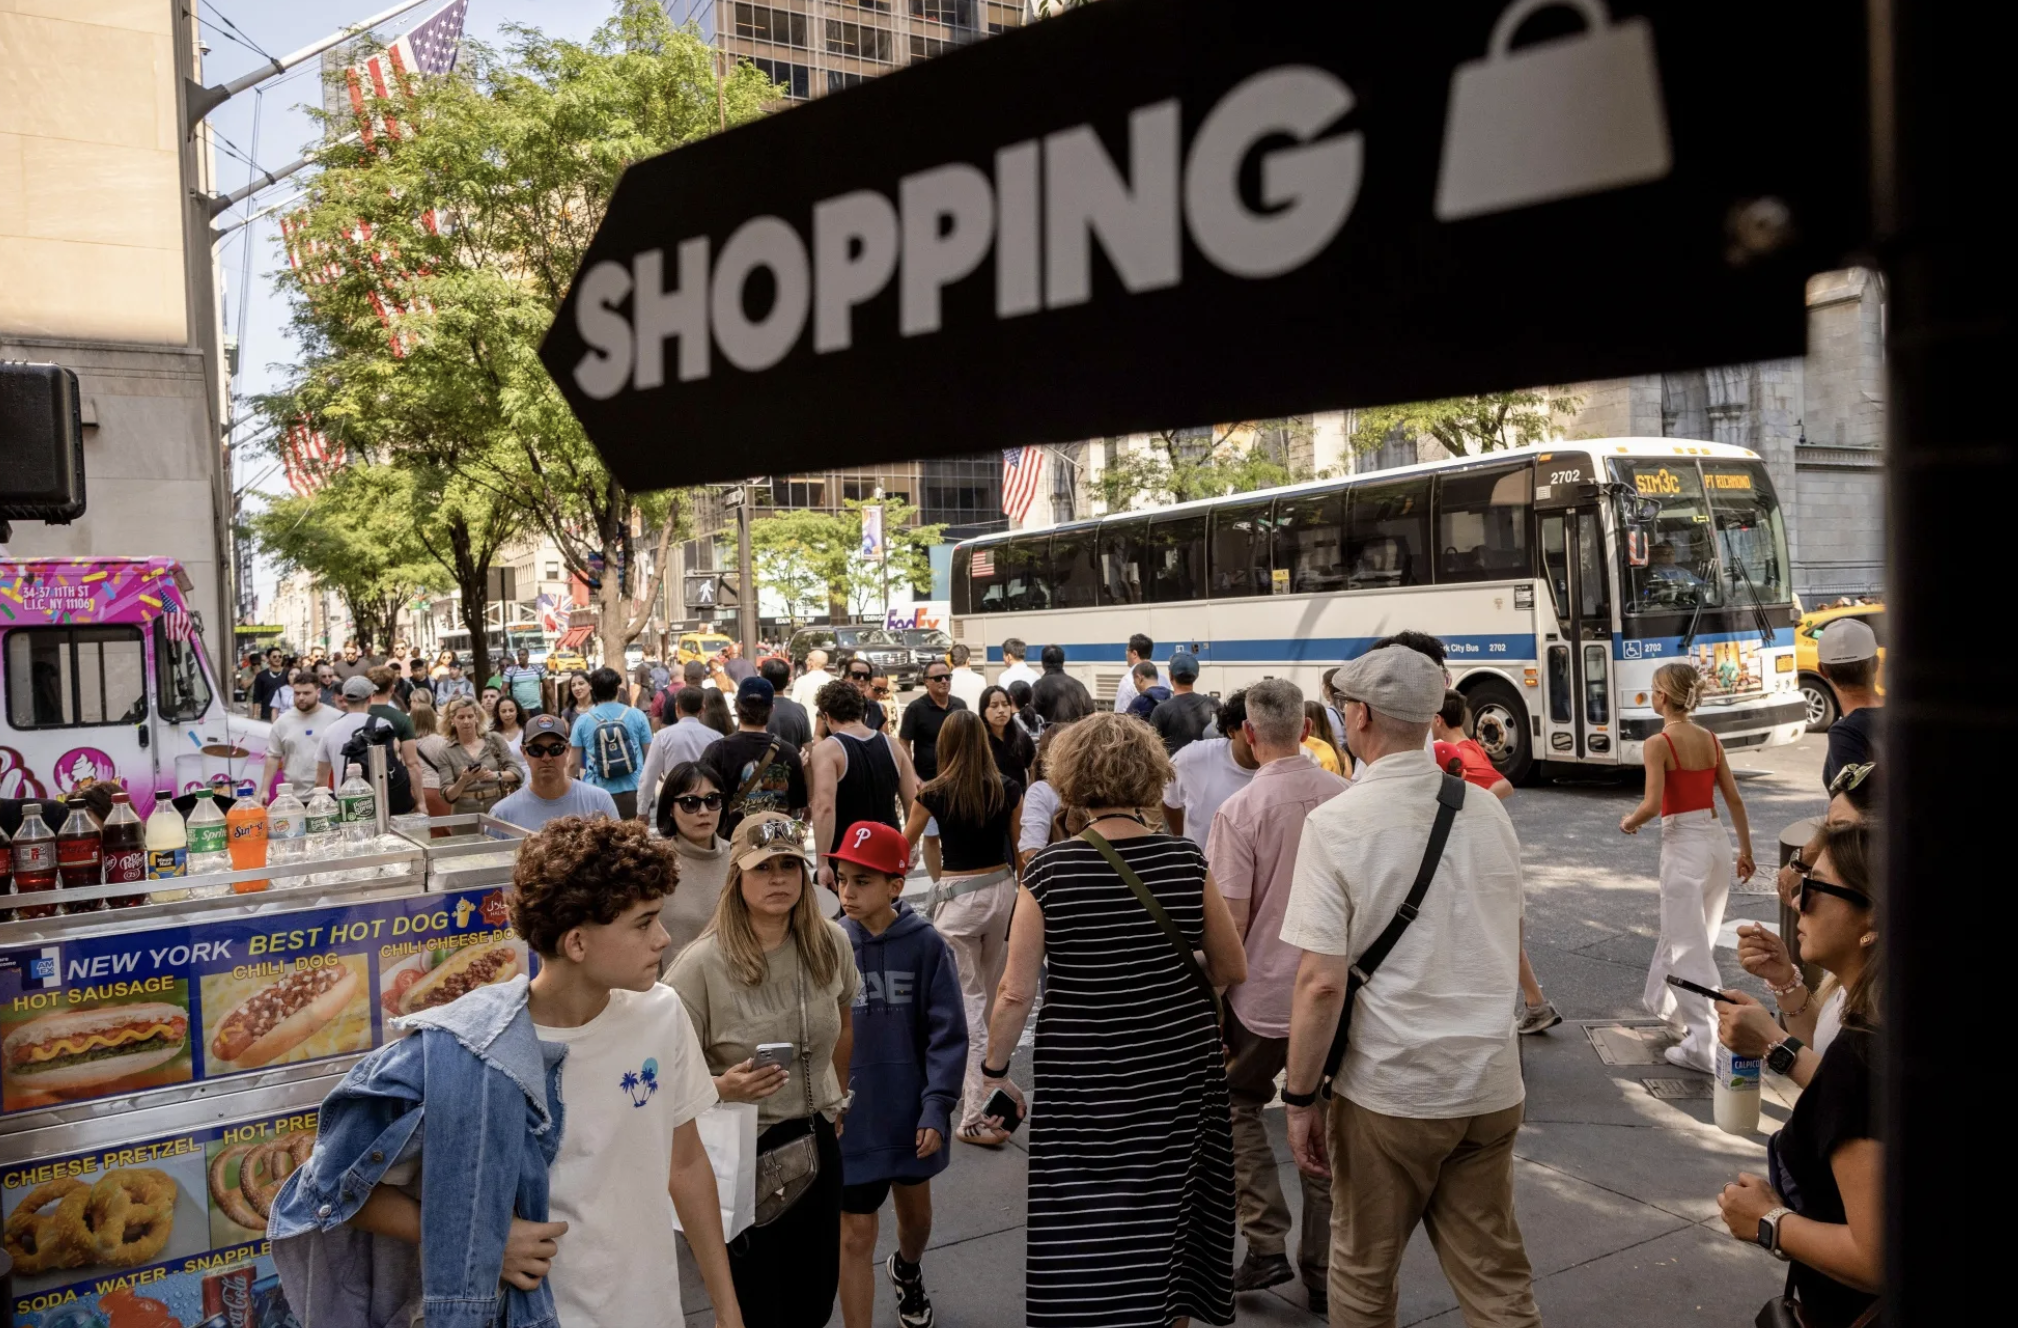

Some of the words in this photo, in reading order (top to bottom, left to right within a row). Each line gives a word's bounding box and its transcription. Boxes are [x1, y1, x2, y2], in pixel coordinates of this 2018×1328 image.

[573, 64, 1363, 400] SHOPPING
[1550, 469, 1580, 485] 2702
[1635, 468, 1681, 494] SIM3C
[1704, 474, 1715, 489] PT
[1715, 474, 1752, 489] RICHMOND
[23, 586, 50, 598] 34-37
[54, 585, 75, 598] 11TH
[77, 585, 90, 598] ST
[49, 598, 63, 610] NY
[65, 598, 91, 609] 11106
[886, 607, 940, 630] FedEx
[1450, 643, 1465, 654] City
[1465, 643, 1480, 652] Bus
[1489, 643, 1507, 652] 2702
[1644, 643, 1662, 653] 2702
[853, 827, 872, 849] P
[67, 951, 141, 981] NEW
[150, 938, 234, 968] YORK
[248, 926, 324, 956] BEST
[326, 919, 388, 945] HOT
[392, 911, 449, 936] DOG
[380, 941, 422, 958] CHILI
[426, 931, 489, 952] CHEESE
[492, 928, 515, 942] DO
[36, 961, 54, 969] AM
[38, 967, 54, 976] EX
[232, 959, 286, 981] CHILI
[295, 952, 339, 973] DOG
[13, 991, 61, 1012] HOT
[68, 974, 175, 1004] SAUSAGE
[1734, 1060, 1760, 1070] CALPICO
[223, 1122, 268, 1146] HOT
[275, 1112, 319, 1135] PRE
[3, 1157, 97, 1190] CHEESE
[103, 1136, 201, 1169] PRETZEL
[17, 1291, 78, 1315] SODA
[96, 1267, 167, 1296] WATER
[184, 1242, 272, 1275] SNAPPLE
[221, 1275, 248, 1328] ca-Cola
